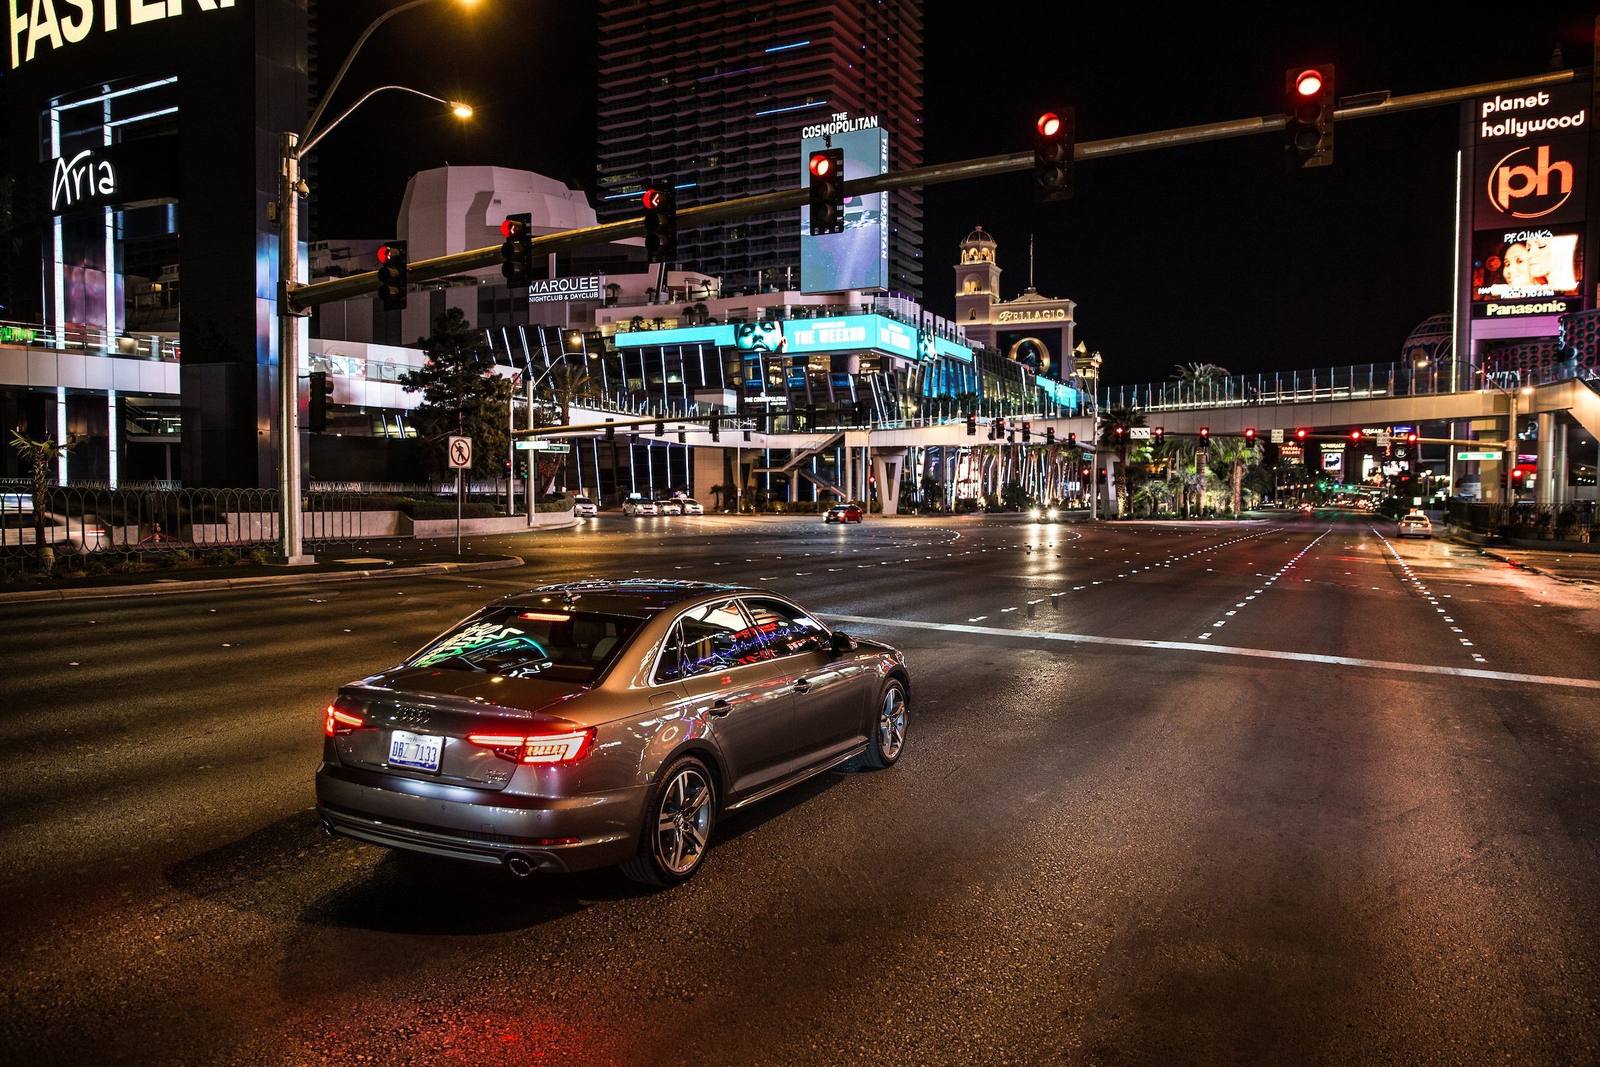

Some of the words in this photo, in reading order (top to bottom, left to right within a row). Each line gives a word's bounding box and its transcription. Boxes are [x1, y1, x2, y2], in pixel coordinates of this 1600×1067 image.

[1482, 92, 1549, 118] planet
[802, 115, 878, 139] COSMOPOLITAN
[832, 112, 848, 122] THE
[1482, 110, 1585, 137] hollywood
[52, 150, 114, 210] Aria
[1497, 146, 1573, 209] ph
[529, 277, 598, 293] MARQUEE
[529, 295, 562, 303] NIGHTCLUB
[570, 292, 598, 300] DAYCLUB
[1487, 300, 1566, 315] Panasonic
[1000, 309, 1065, 321] BELLAGIO
[414, 743, 437, 763] 7133
